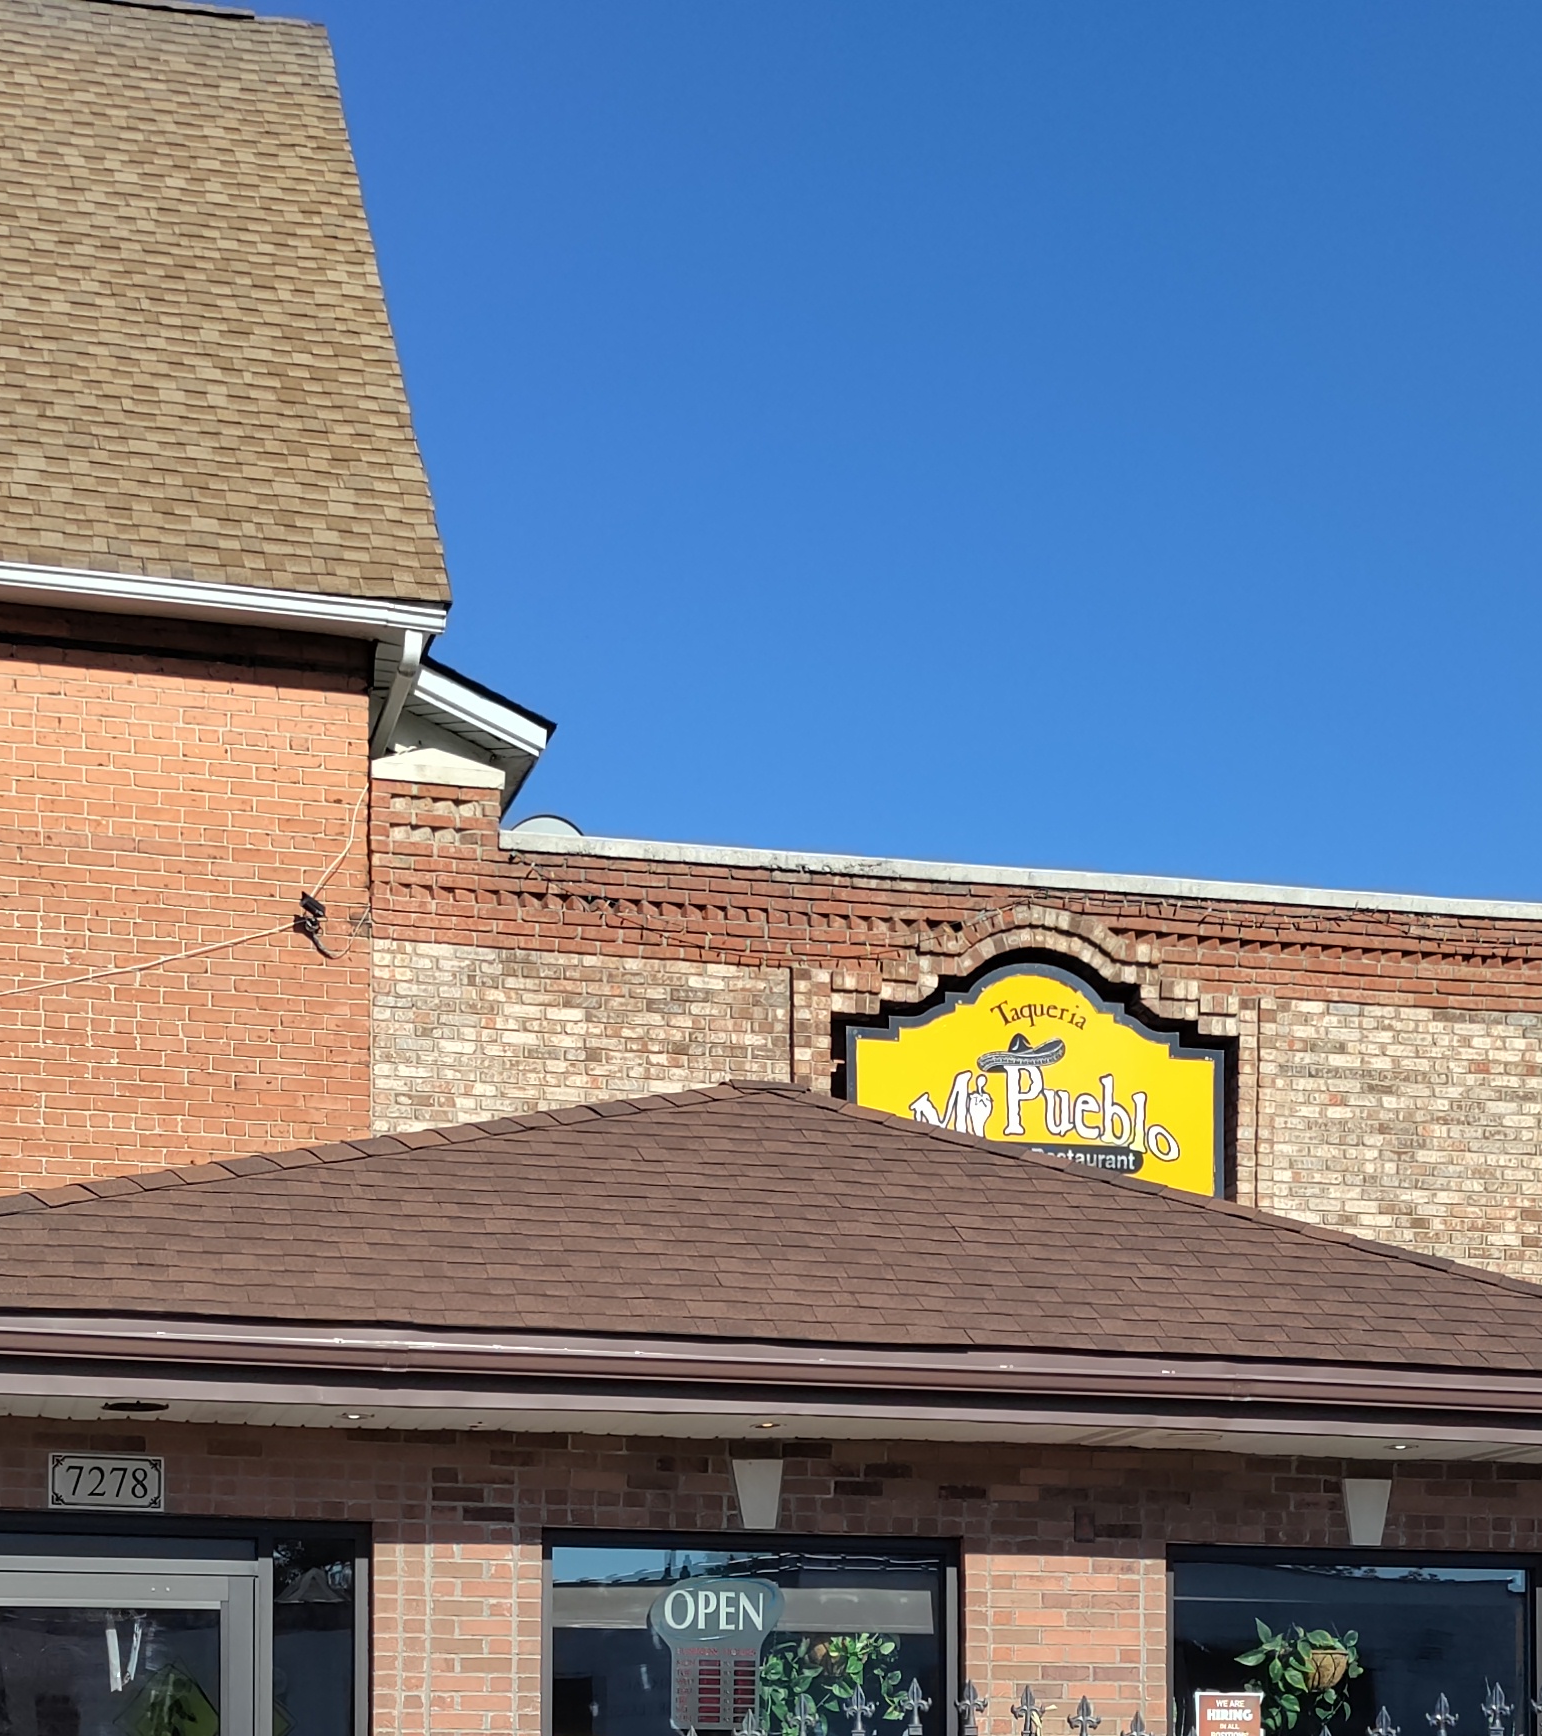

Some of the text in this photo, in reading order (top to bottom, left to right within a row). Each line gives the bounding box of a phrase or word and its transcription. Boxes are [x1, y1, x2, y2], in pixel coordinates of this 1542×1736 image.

[989, 1000, 1087, 1030] Taqueria
[909, 1066, 1181, 1162] Mi Pueblo
[1031, 1147, 1136, 1170] taurant
[66, 1466, 148, 1499] 7278
[664, 1589, 764, 1631] OPEN
[1207, 1709, 1253, 1721] HIRING
